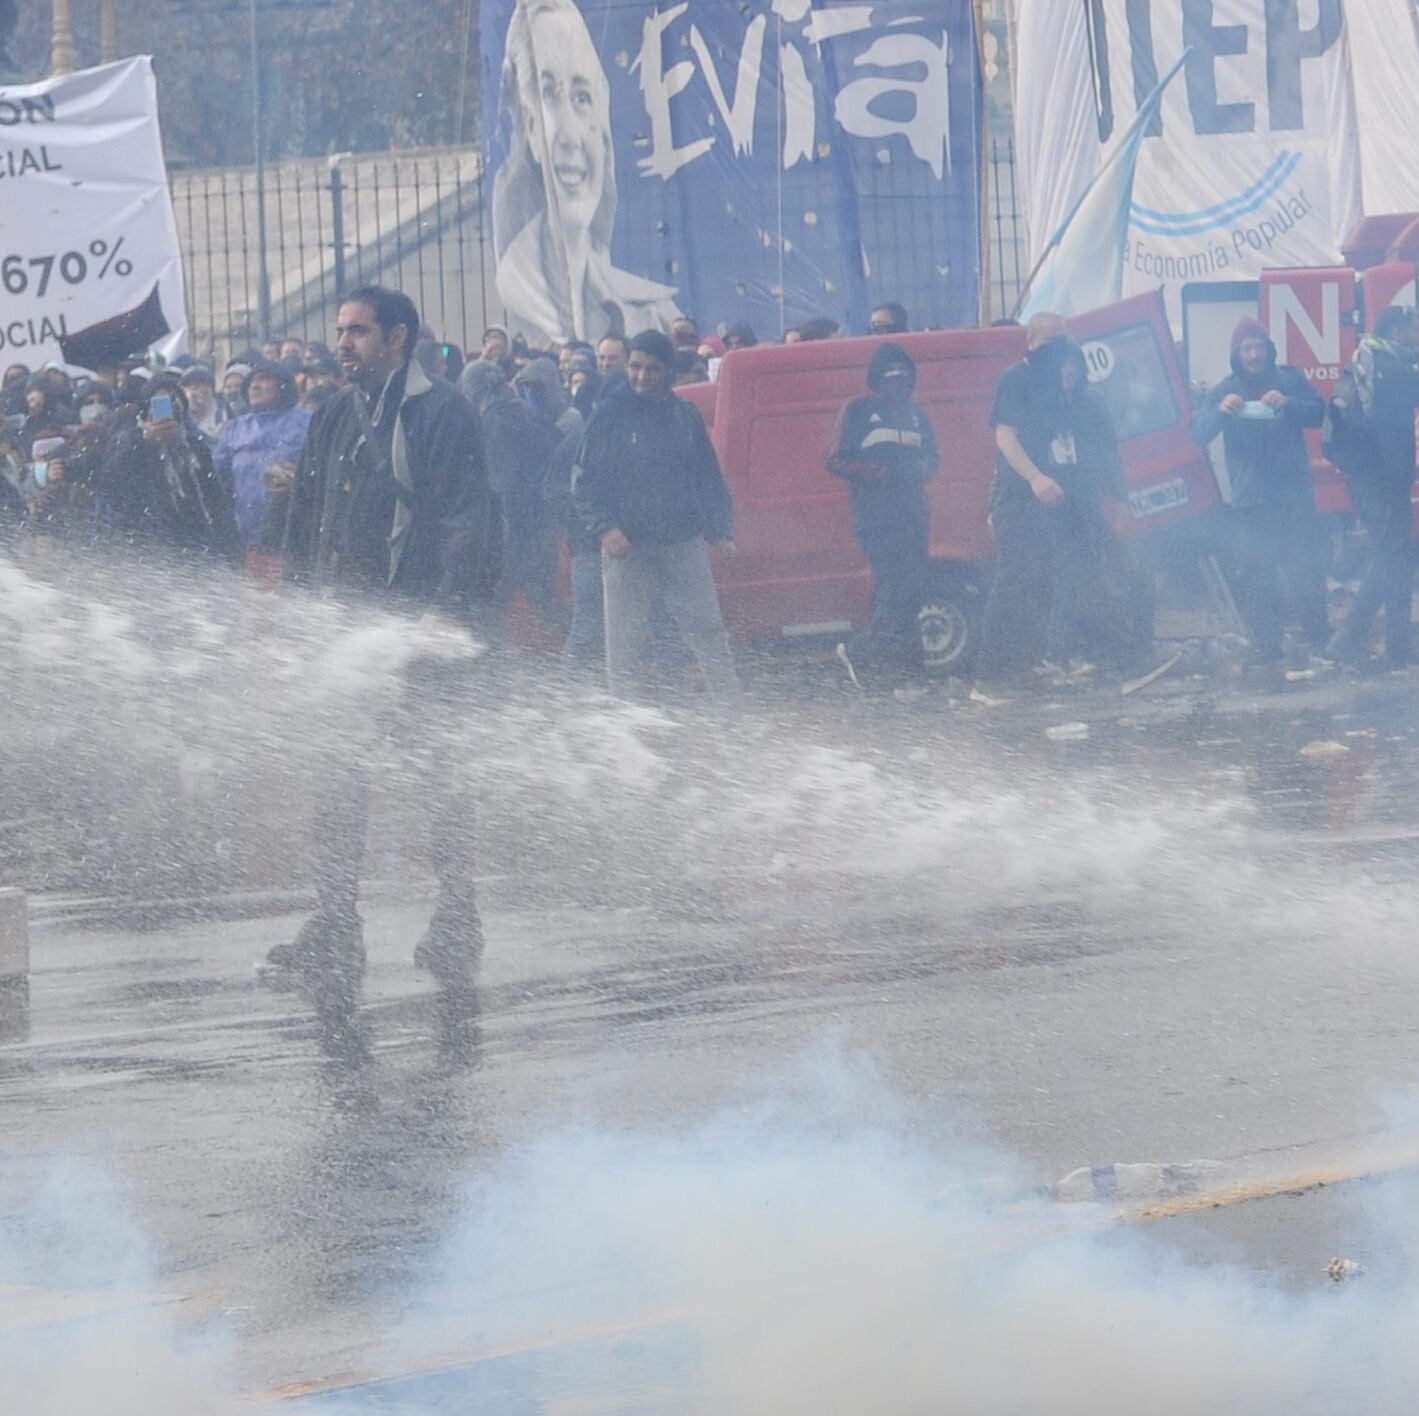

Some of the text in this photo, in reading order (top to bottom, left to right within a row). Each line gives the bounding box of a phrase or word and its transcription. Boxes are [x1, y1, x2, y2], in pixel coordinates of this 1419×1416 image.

[1134, 240, 1230, 279] Economía
[1232, 188, 1313, 260] Popular
[1, 237, 133, 298] 670%
[0, 313, 68, 354] CIAL
